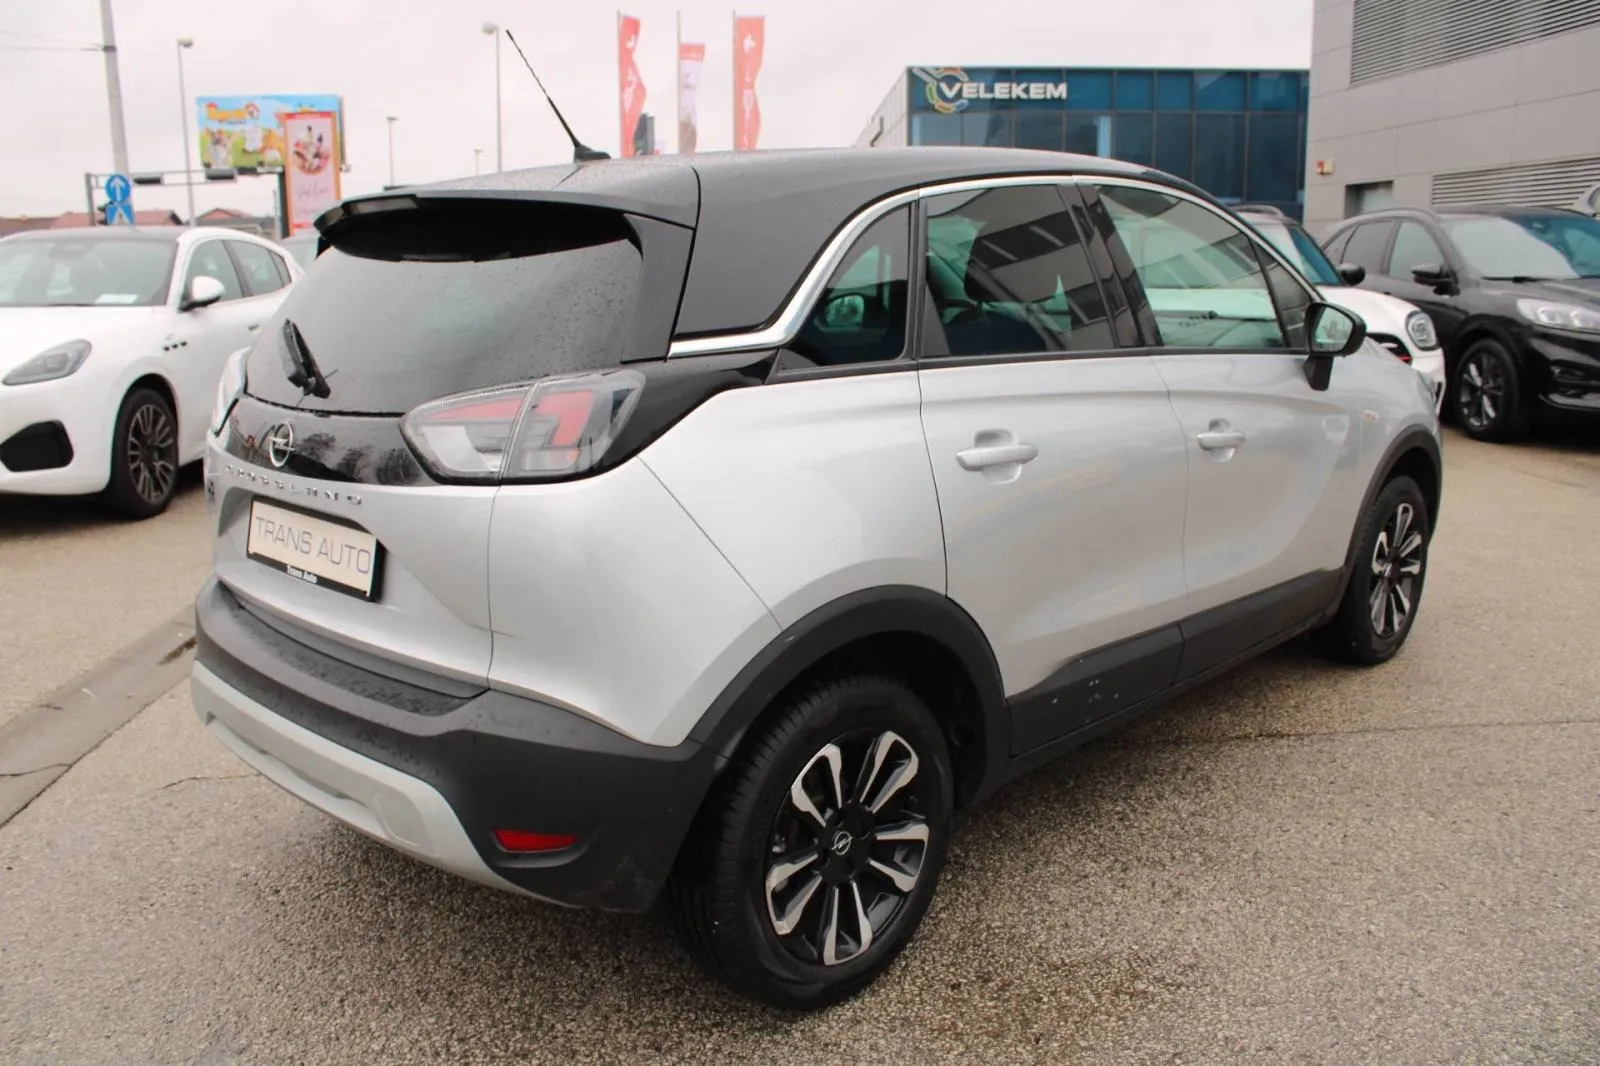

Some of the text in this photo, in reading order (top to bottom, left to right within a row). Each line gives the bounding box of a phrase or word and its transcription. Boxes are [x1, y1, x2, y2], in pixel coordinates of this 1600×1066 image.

[939, 82, 1067, 100] VELEKEM
[256, 517, 371, 574] TRANS AUTO
